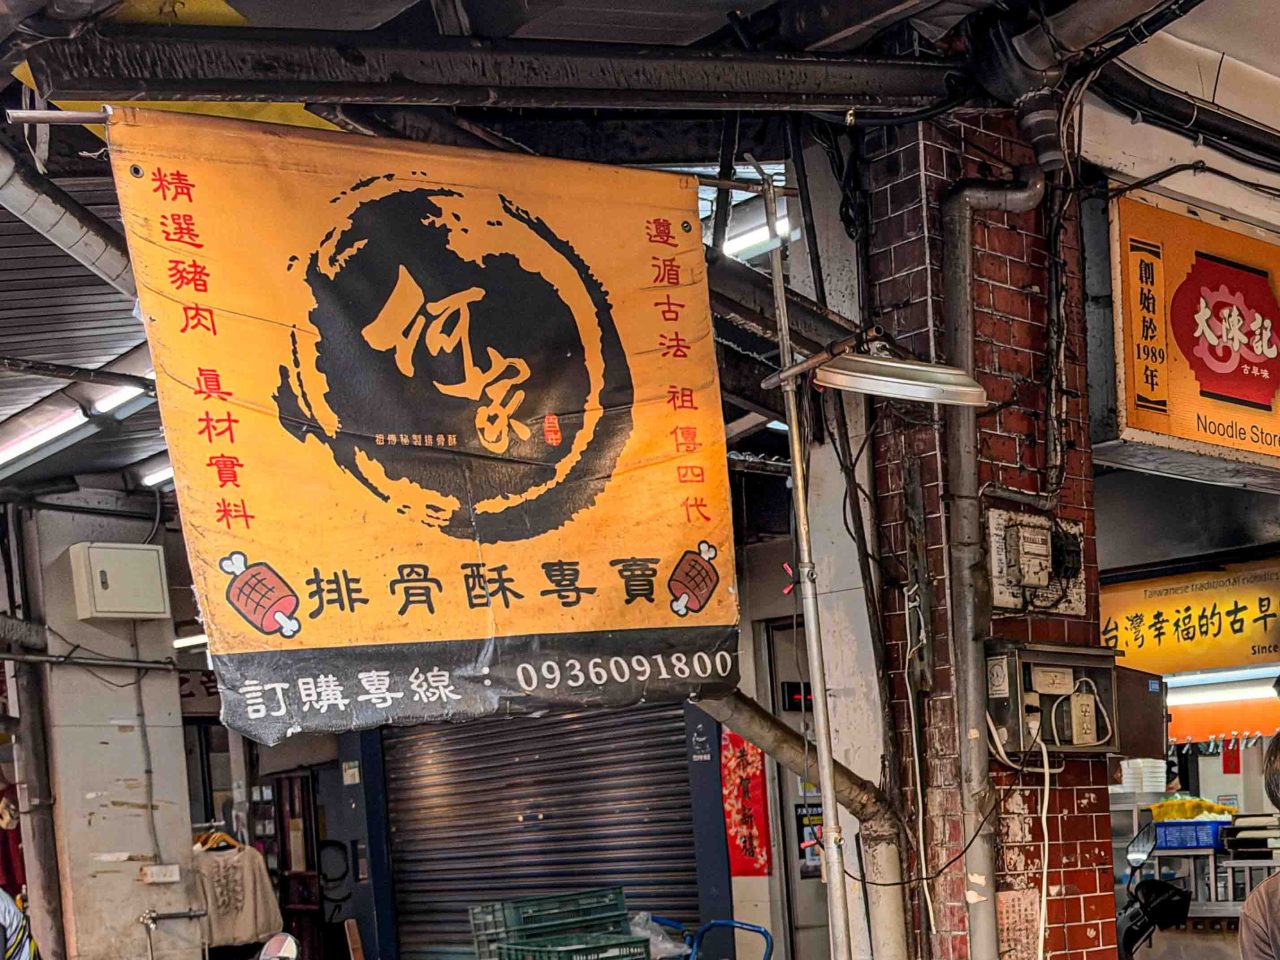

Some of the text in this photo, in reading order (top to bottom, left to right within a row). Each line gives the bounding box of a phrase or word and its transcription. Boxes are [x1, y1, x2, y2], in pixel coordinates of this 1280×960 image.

[151, 167, 217, 336] 精選豬肉
[361, 264, 531, 454] 何家
[1193, 297, 1278, 359] 大陳記
[645, 218, 711, 523] 遵循古法 祖傳四代
[1241, 363, 1270, 380] 古早味
[1197, 413, 1247, 441] Noodle
[306, 556, 661, 619] 排骨酥專賣
[515, 650, 733, 693] 0936091800
[1251, 644, 1279, 656] Since
